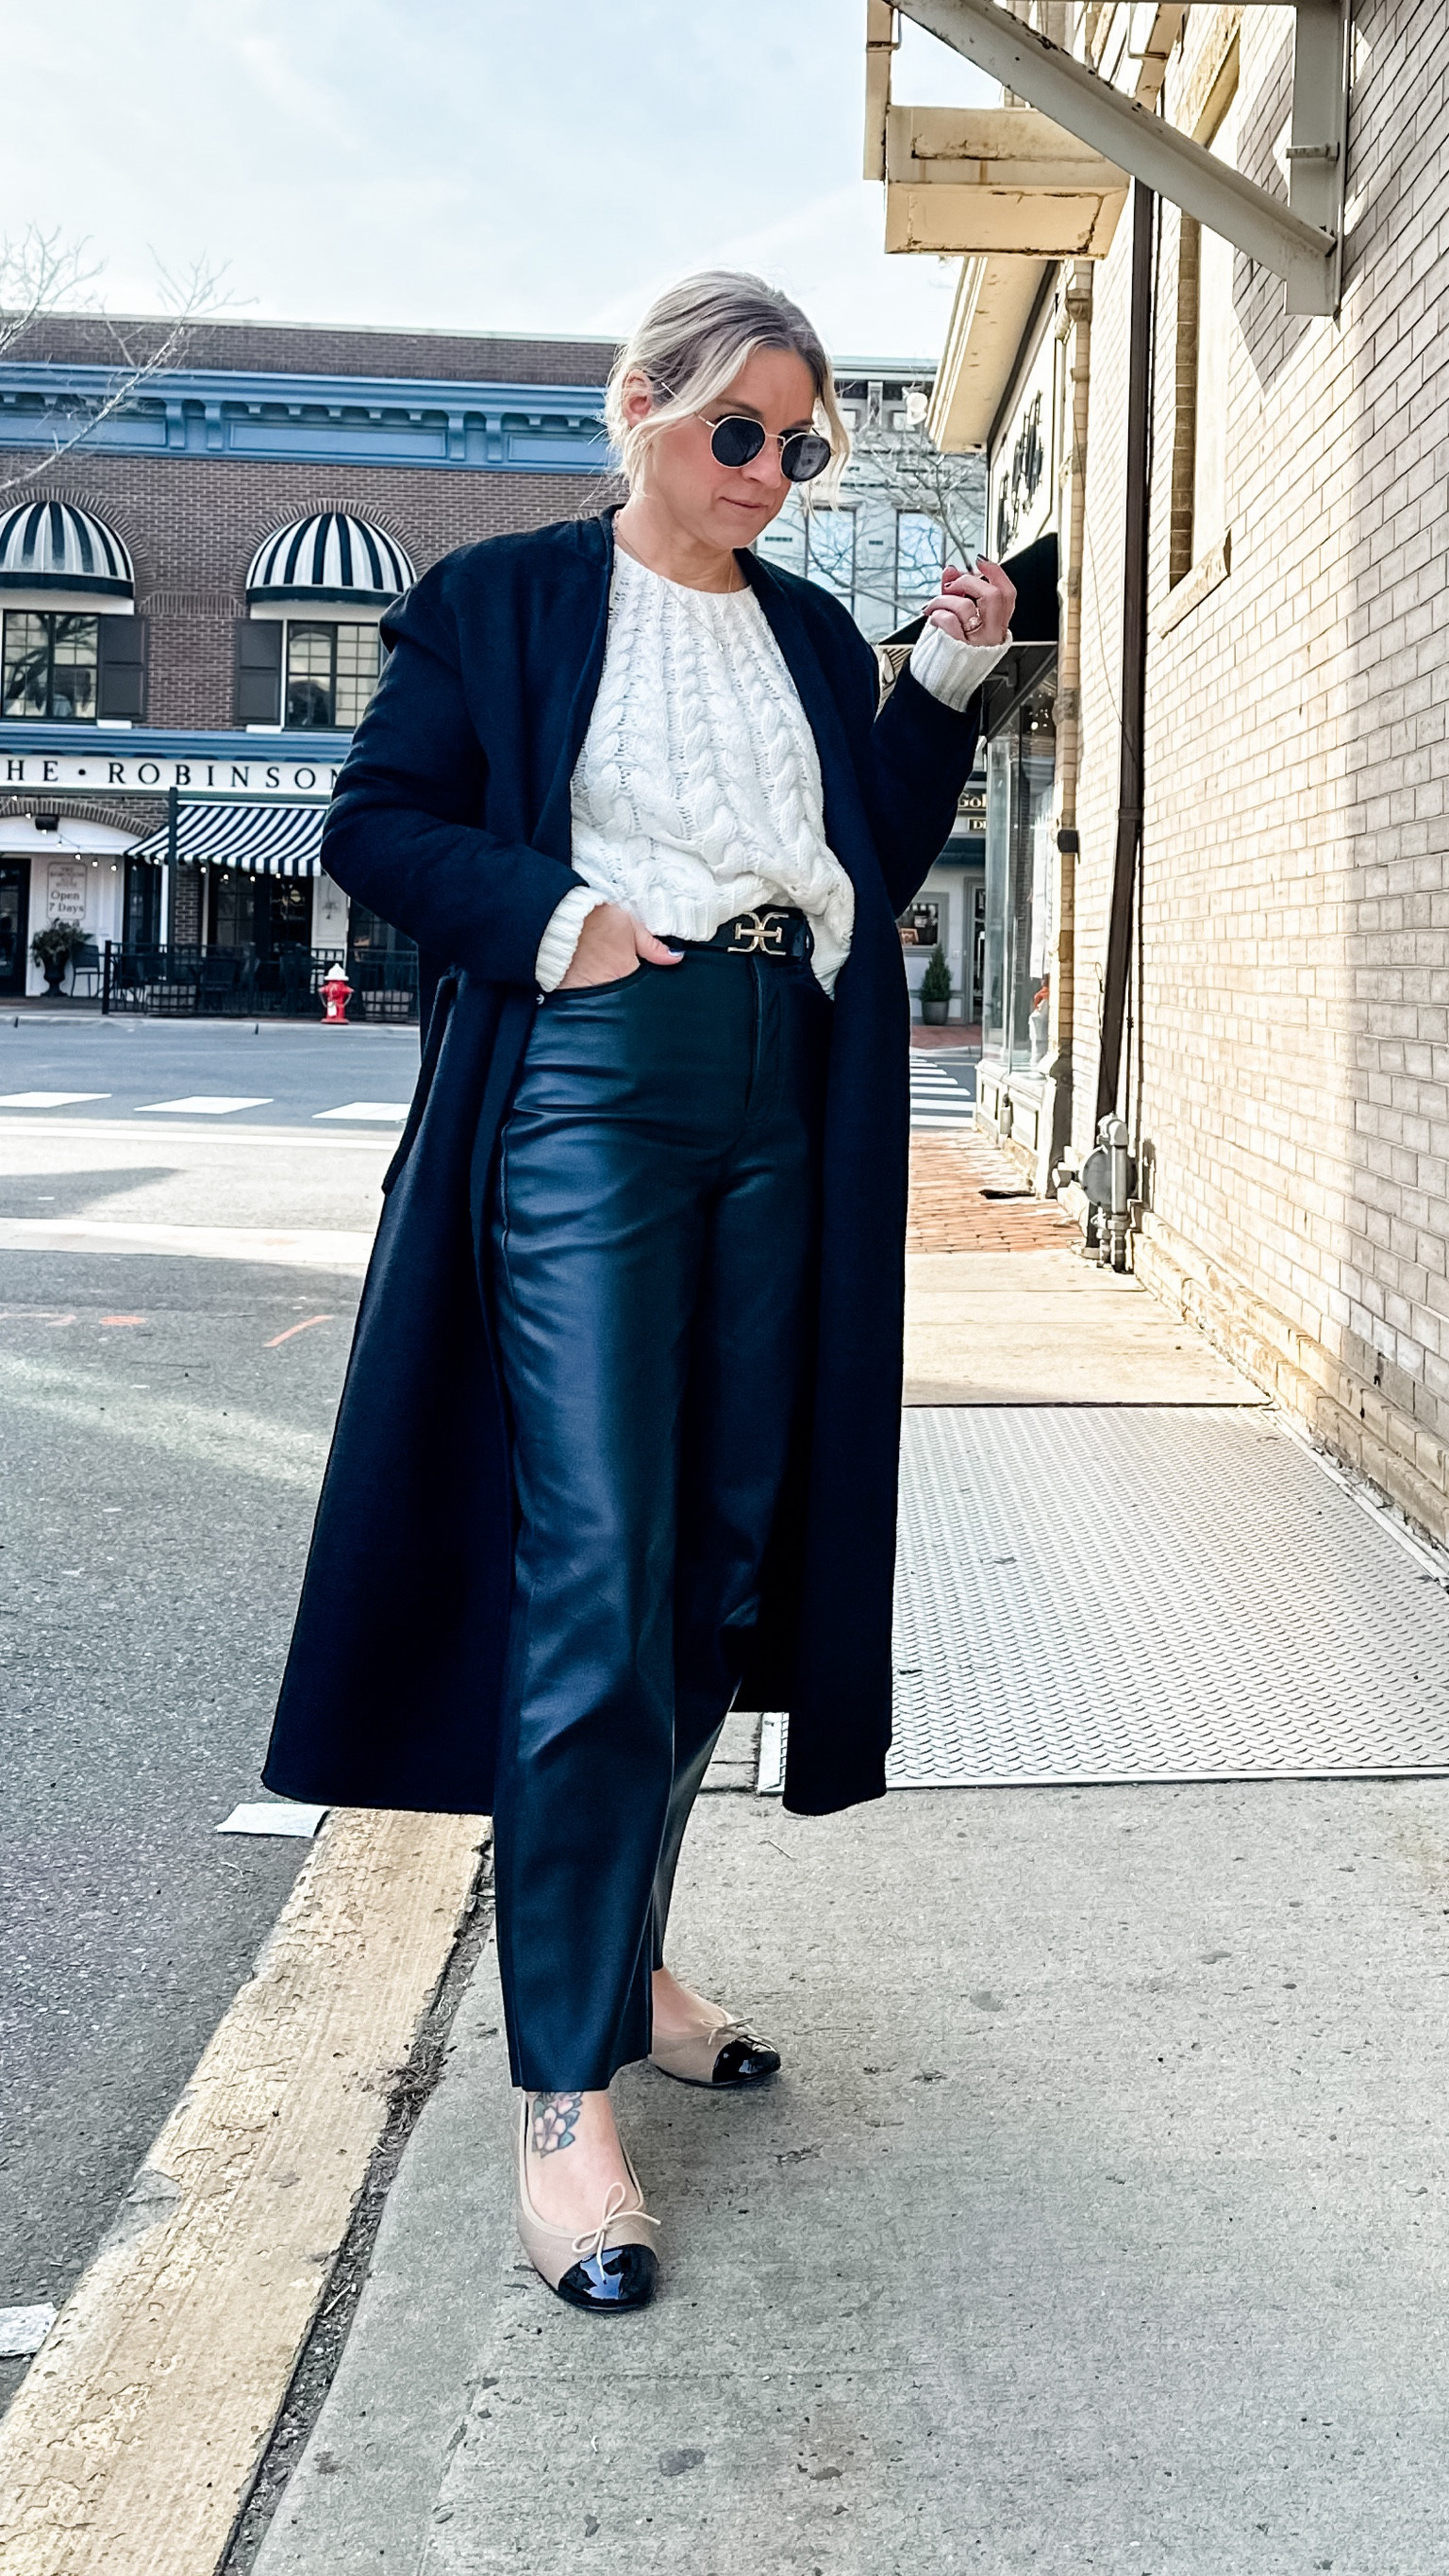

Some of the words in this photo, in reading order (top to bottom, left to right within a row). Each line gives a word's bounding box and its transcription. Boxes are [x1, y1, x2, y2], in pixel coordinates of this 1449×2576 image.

[7, 759, 59, 782] HE
[958, 791, 987, 808] Gol
[50, 889, 80, 902] Open
[49, 902, 56, 912] 7
[58, 902, 84, 914] Days
